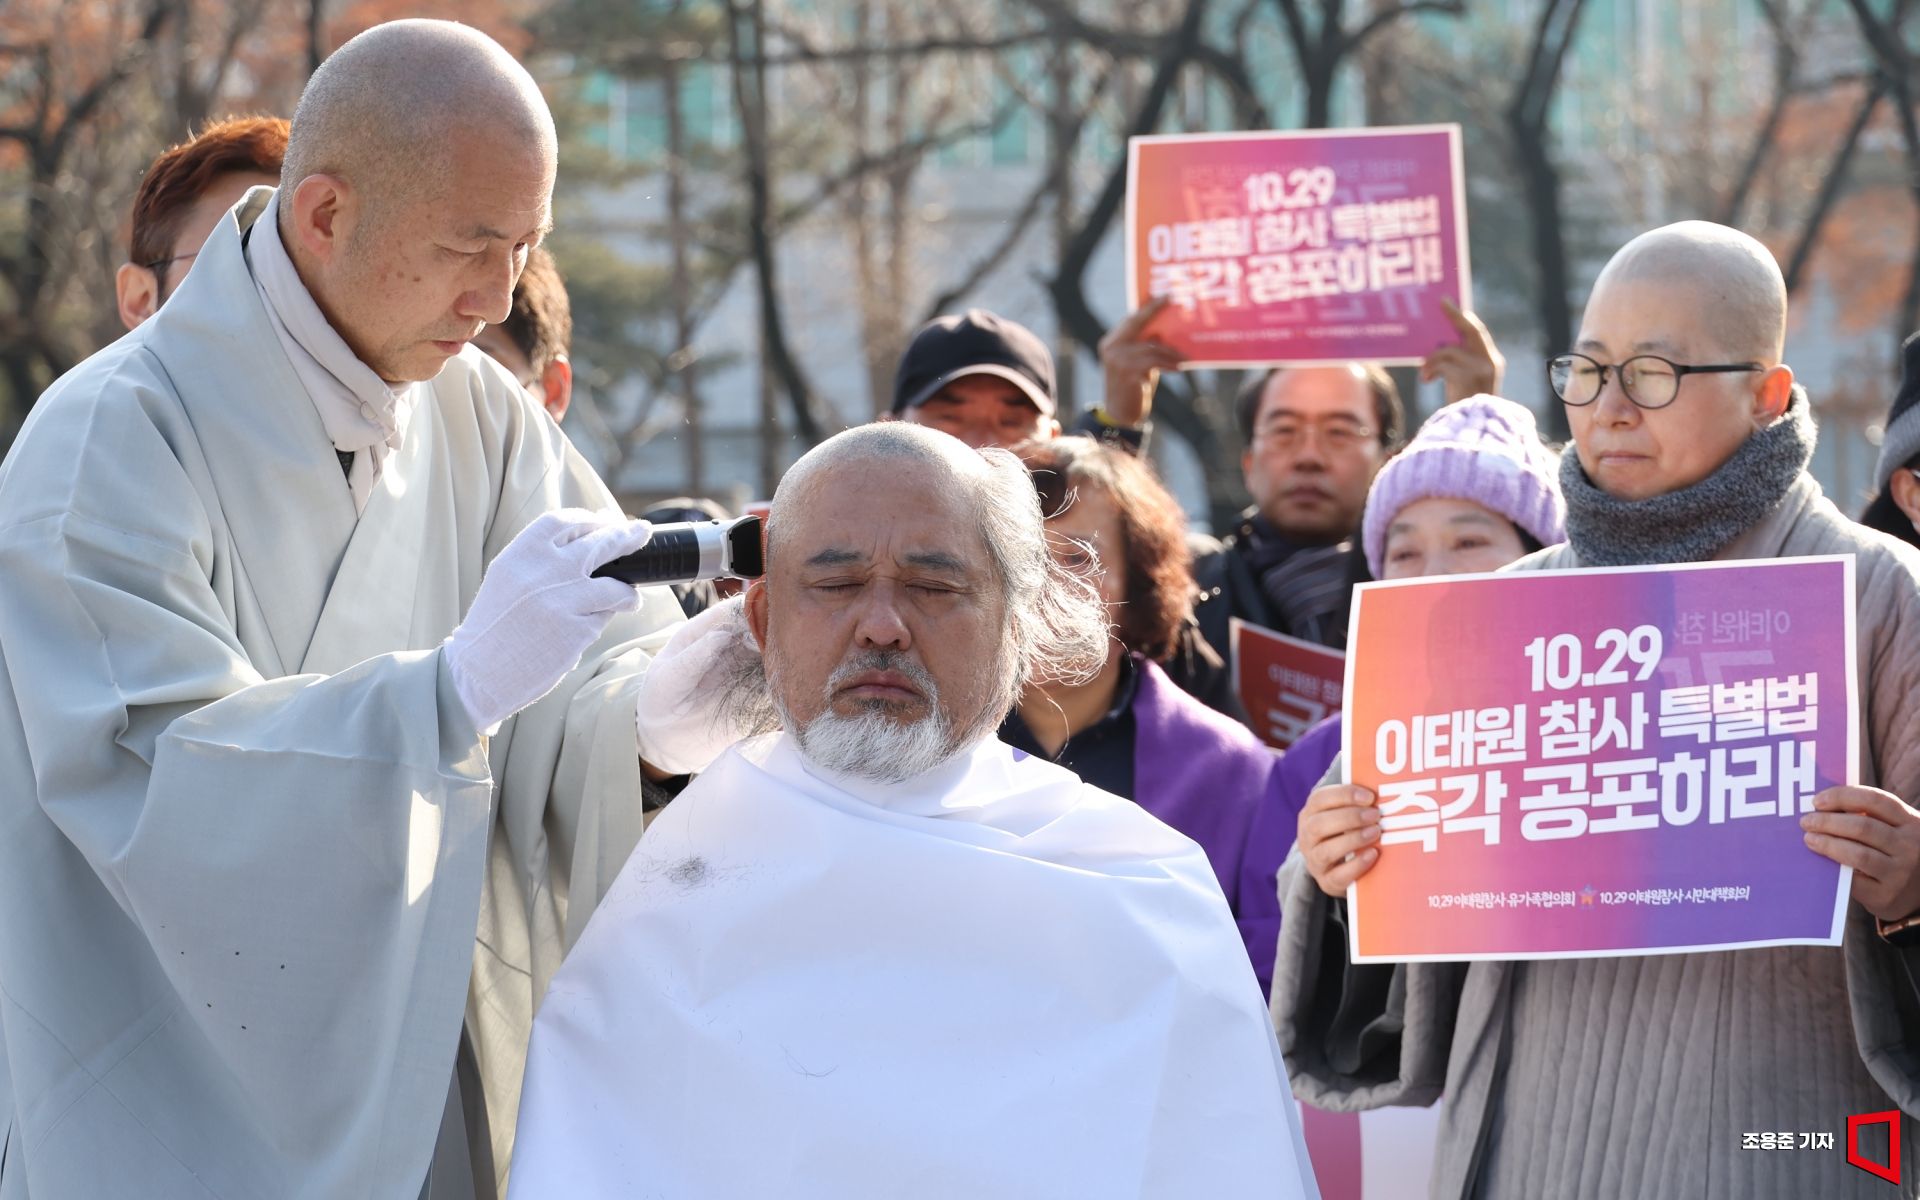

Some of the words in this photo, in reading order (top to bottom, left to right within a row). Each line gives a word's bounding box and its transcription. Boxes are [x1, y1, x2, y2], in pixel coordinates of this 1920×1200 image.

[1243, 165, 1336, 213] 10.29
[1148, 217, 1251, 263] 이태원
[1255, 207, 1328, 254] 참사
[1331, 195, 1441, 244] 특별법
[1149, 258, 1244, 312] 즉각
[1524, 624, 1663, 692] 10.29
[1375, 703, 1527, 776] 이태원
[1539, 691, 1649, 759] 참사
[1658, 672, 1818, 744] 특별법
[1378, 770, 1508, 853] 즉각
[1519, 740, 1816, 842] 공포하라!
[1507, 891, 1576, 909] 유가족협의회
[1684, 885, 1750, 903] 시민대책회의
